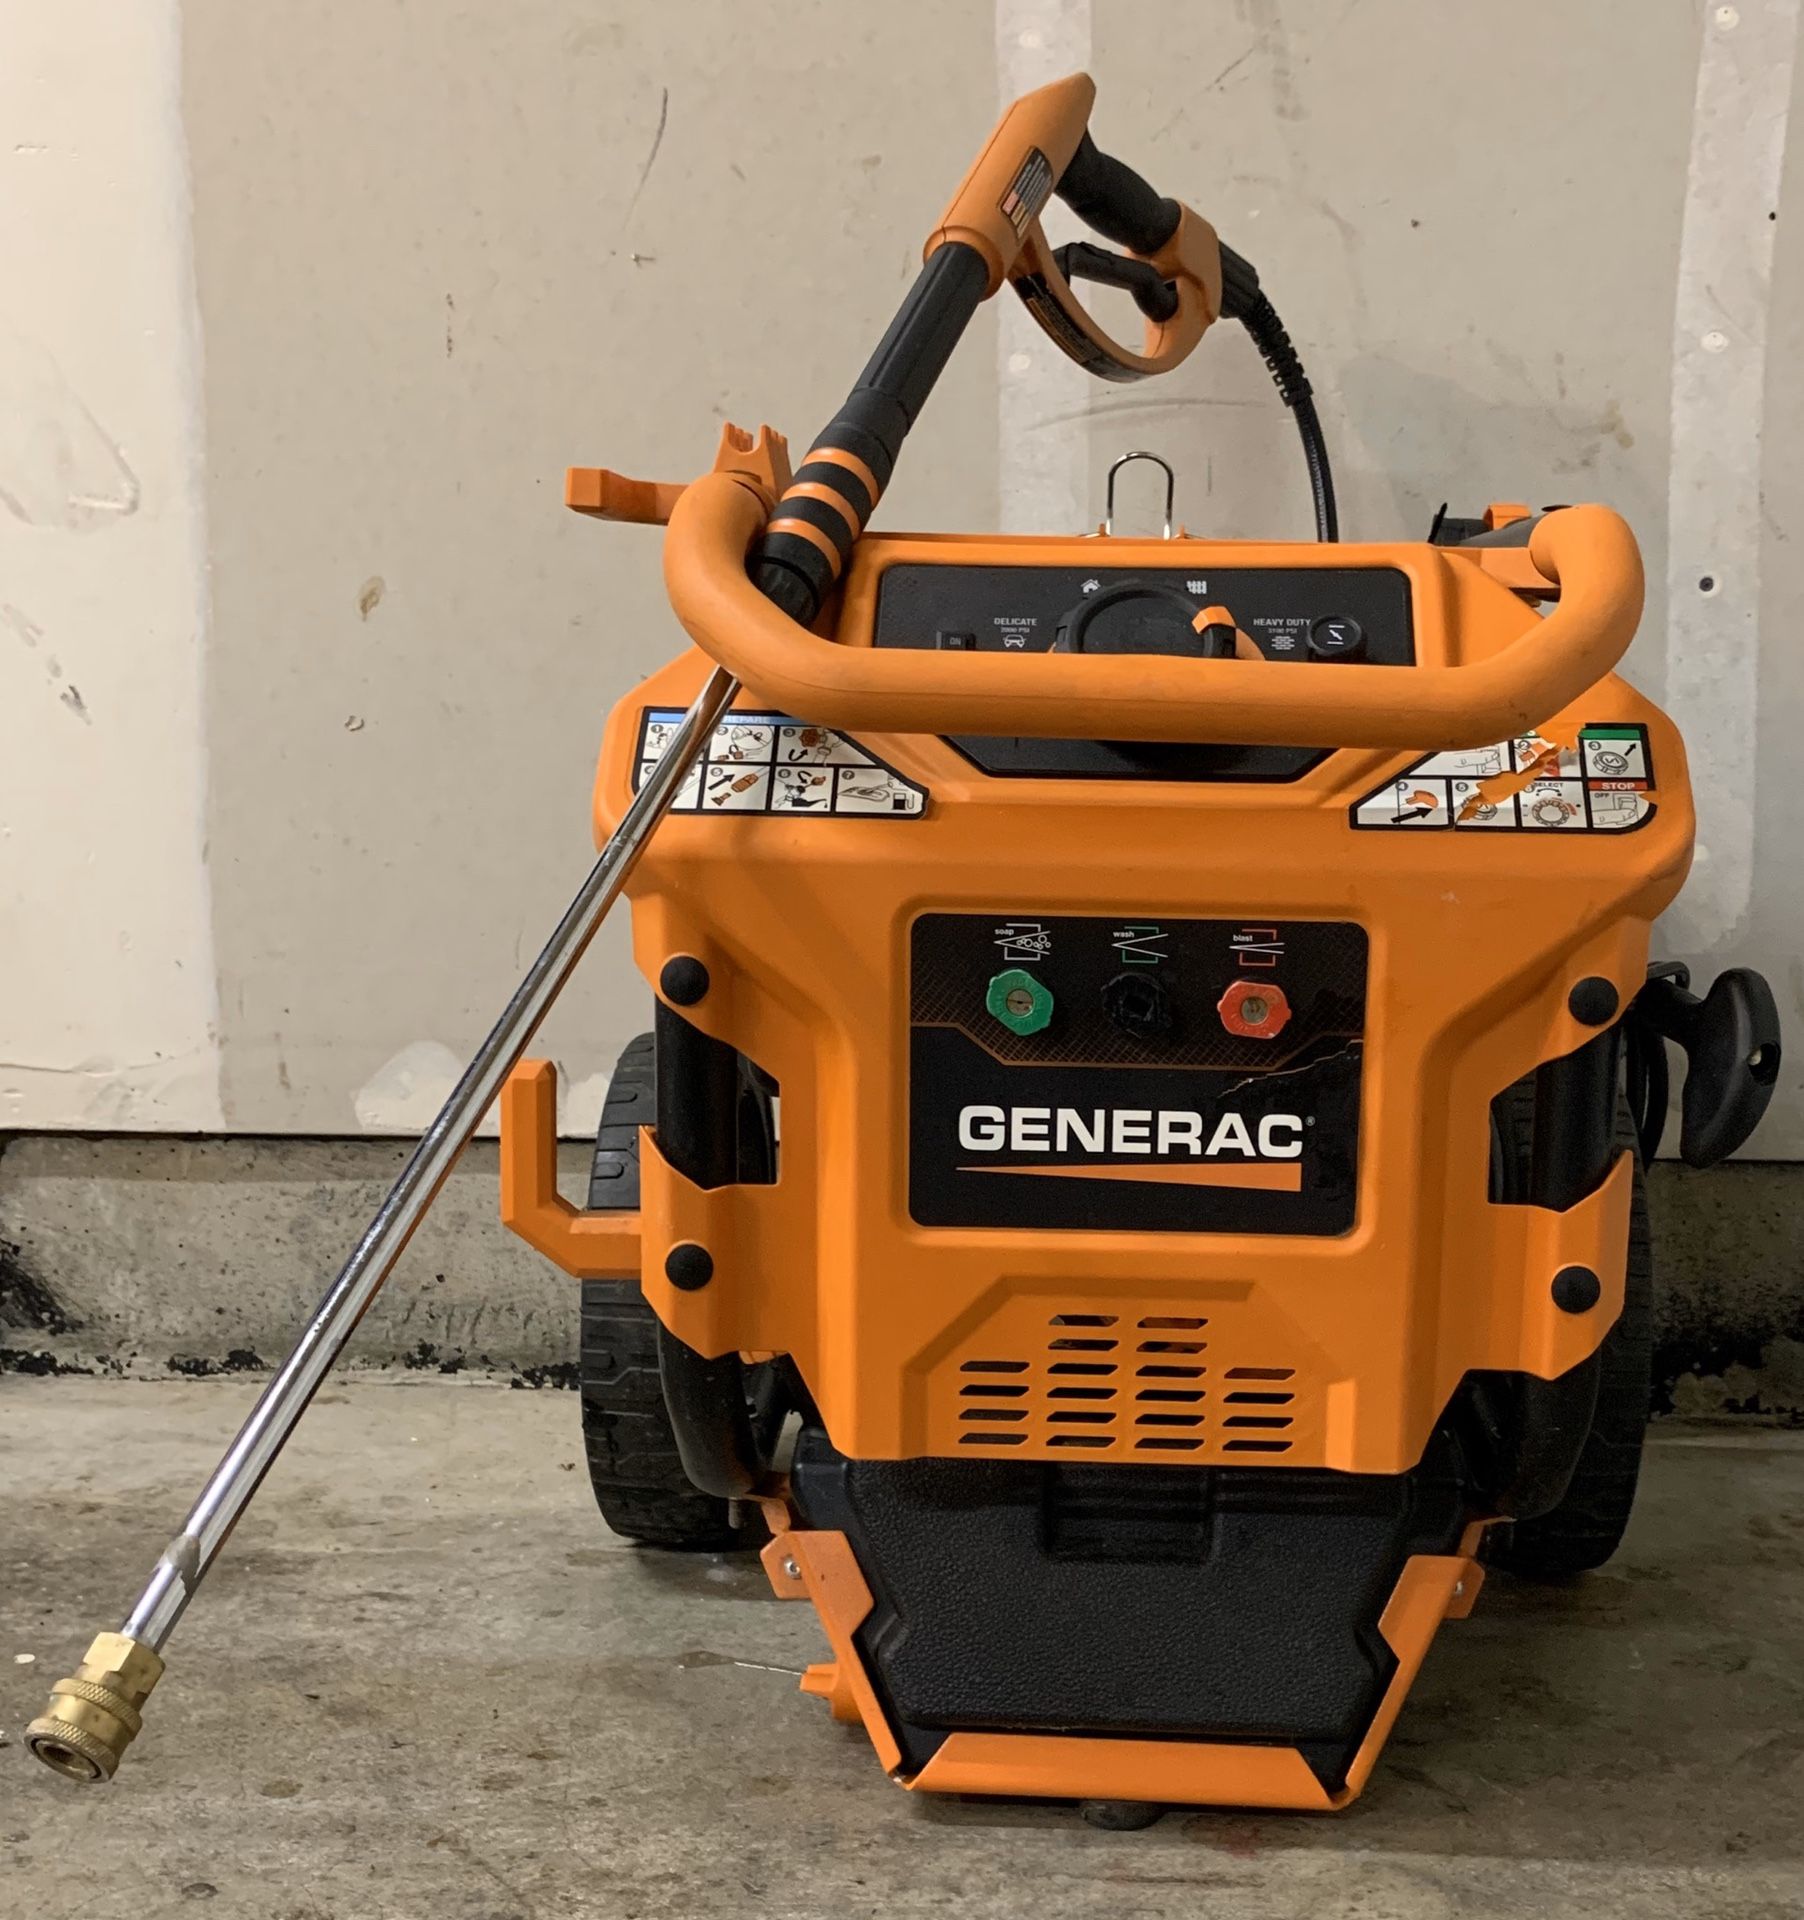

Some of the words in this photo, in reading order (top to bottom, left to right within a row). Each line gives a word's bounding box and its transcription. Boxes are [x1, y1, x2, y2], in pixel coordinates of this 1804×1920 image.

[993, 617, 1038, 626] DELICATE
[1253, 618, 1284, 626] HEAVY
[1286, 618, 1311, 626] DUTY
[1601, 781, 1636, 790] STOP
[994, 927, 1015, 936] soap
[1112, 930, 1135, 939] wash
[1232, 934, 1254, 943] blast
[958, 1104, 1303, 1158] GENERAC
